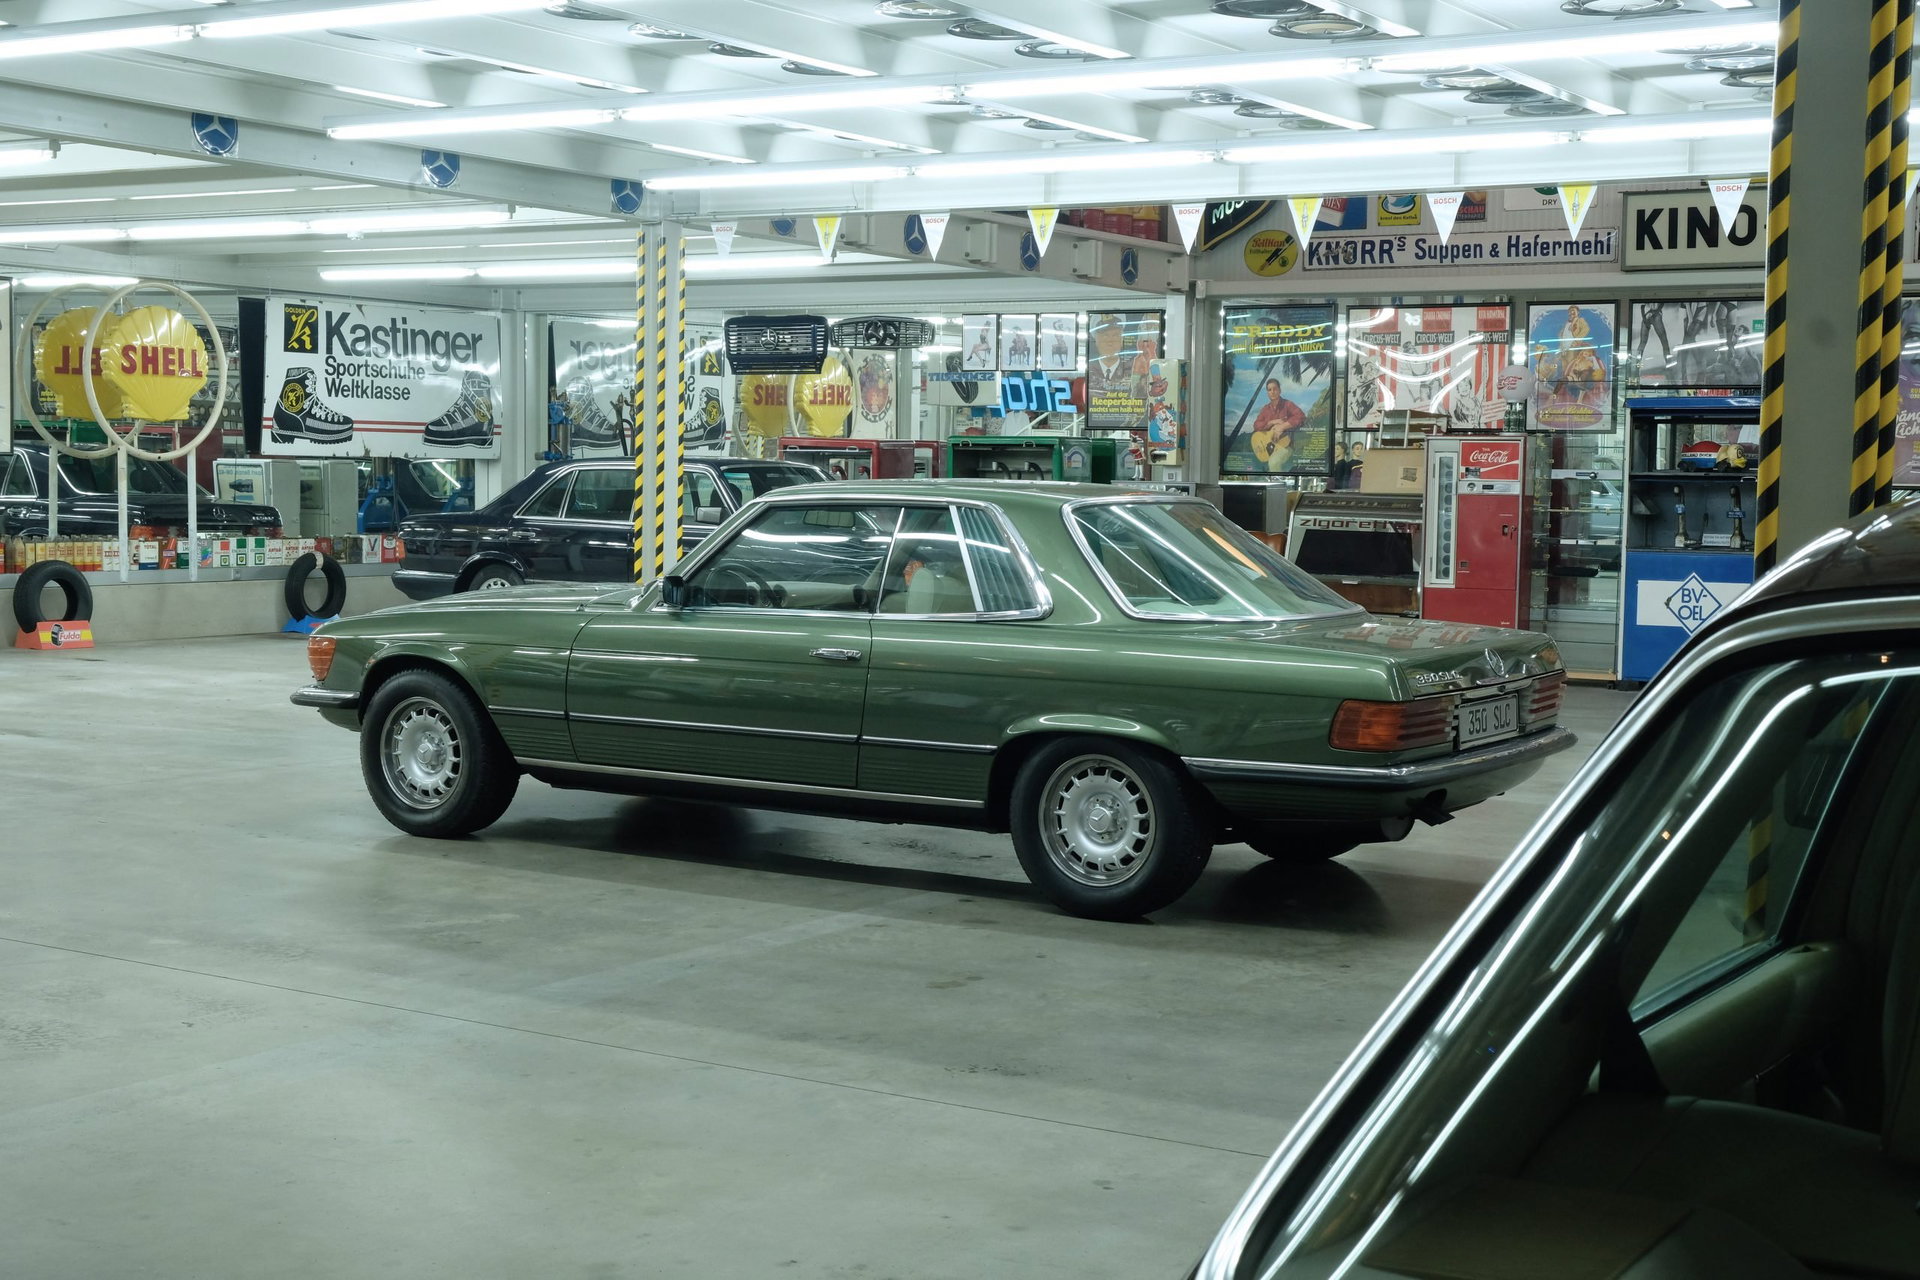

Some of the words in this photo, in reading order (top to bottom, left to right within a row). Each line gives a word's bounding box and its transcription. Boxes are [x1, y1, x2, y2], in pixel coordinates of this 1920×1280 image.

[1716, 184, 1742, 192] BOSCH
[1433, 197, 1458, 205] BOSCH
[1636, 204, 1758, 251] KINO
[1414, 237, 1483, 263] Suppen
[1489, 243, 1500, 258] &
[1507, 231, 1611, 258] Hafermehl
[284, 307, 306, 315] GOLDEN
[1232, 324, 1326, 338] FREDDY
[1416, 332, 1454, 344] CIRCUS-WELT
[325, 310, 483, 373] Kastinger
[1362, 333, 1400, 345] CIRCUS-WELT
[121, 344, 204, 378] SHELL
[324, 355, 426, 381] Sportschuhe
[324, 377, 411, 400] Weltklasse
[1092, 397, 1143, 407] Reeperbahn
[1469, 449, 1510, 463] Coca-Cola
[1681, 588, 1708, 604] BV-
[1677, 604, 1706, 621] OEL
[59, 630, 81, 641] Fulda
[1468, 707, 1488, 736] 350
[1493, 703, 1511, 731] SLC
